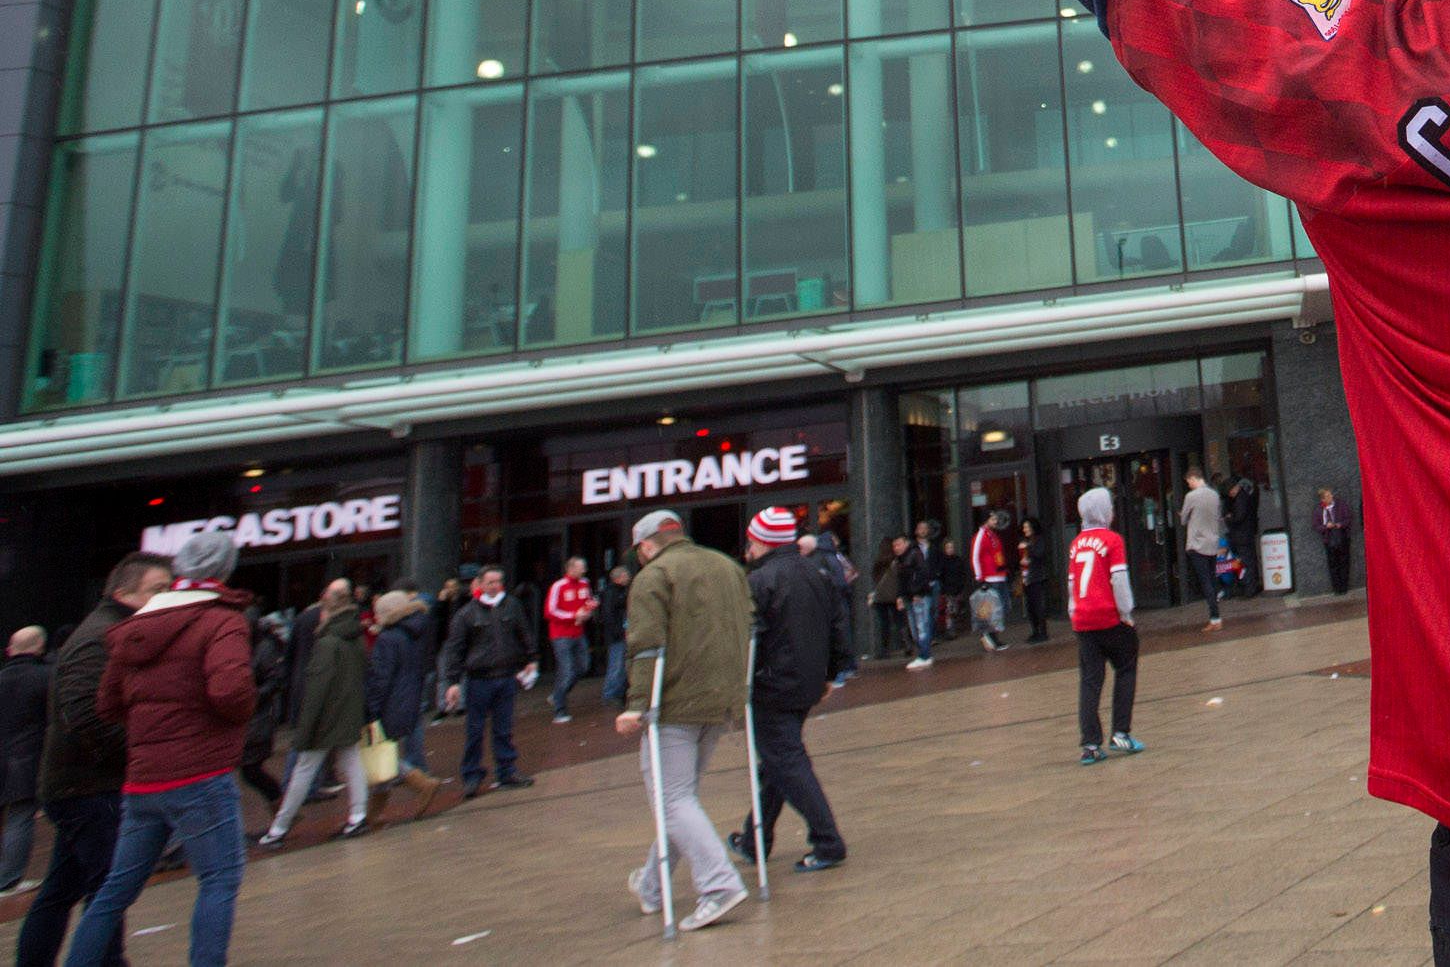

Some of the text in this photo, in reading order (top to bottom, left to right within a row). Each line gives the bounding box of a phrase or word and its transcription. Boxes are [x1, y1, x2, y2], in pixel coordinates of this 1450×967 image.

[1099, 435, 1121, 451] E3
[582, 444, 809, 505] ENTRANCE
[1076, 550, 1095, 599] 7
